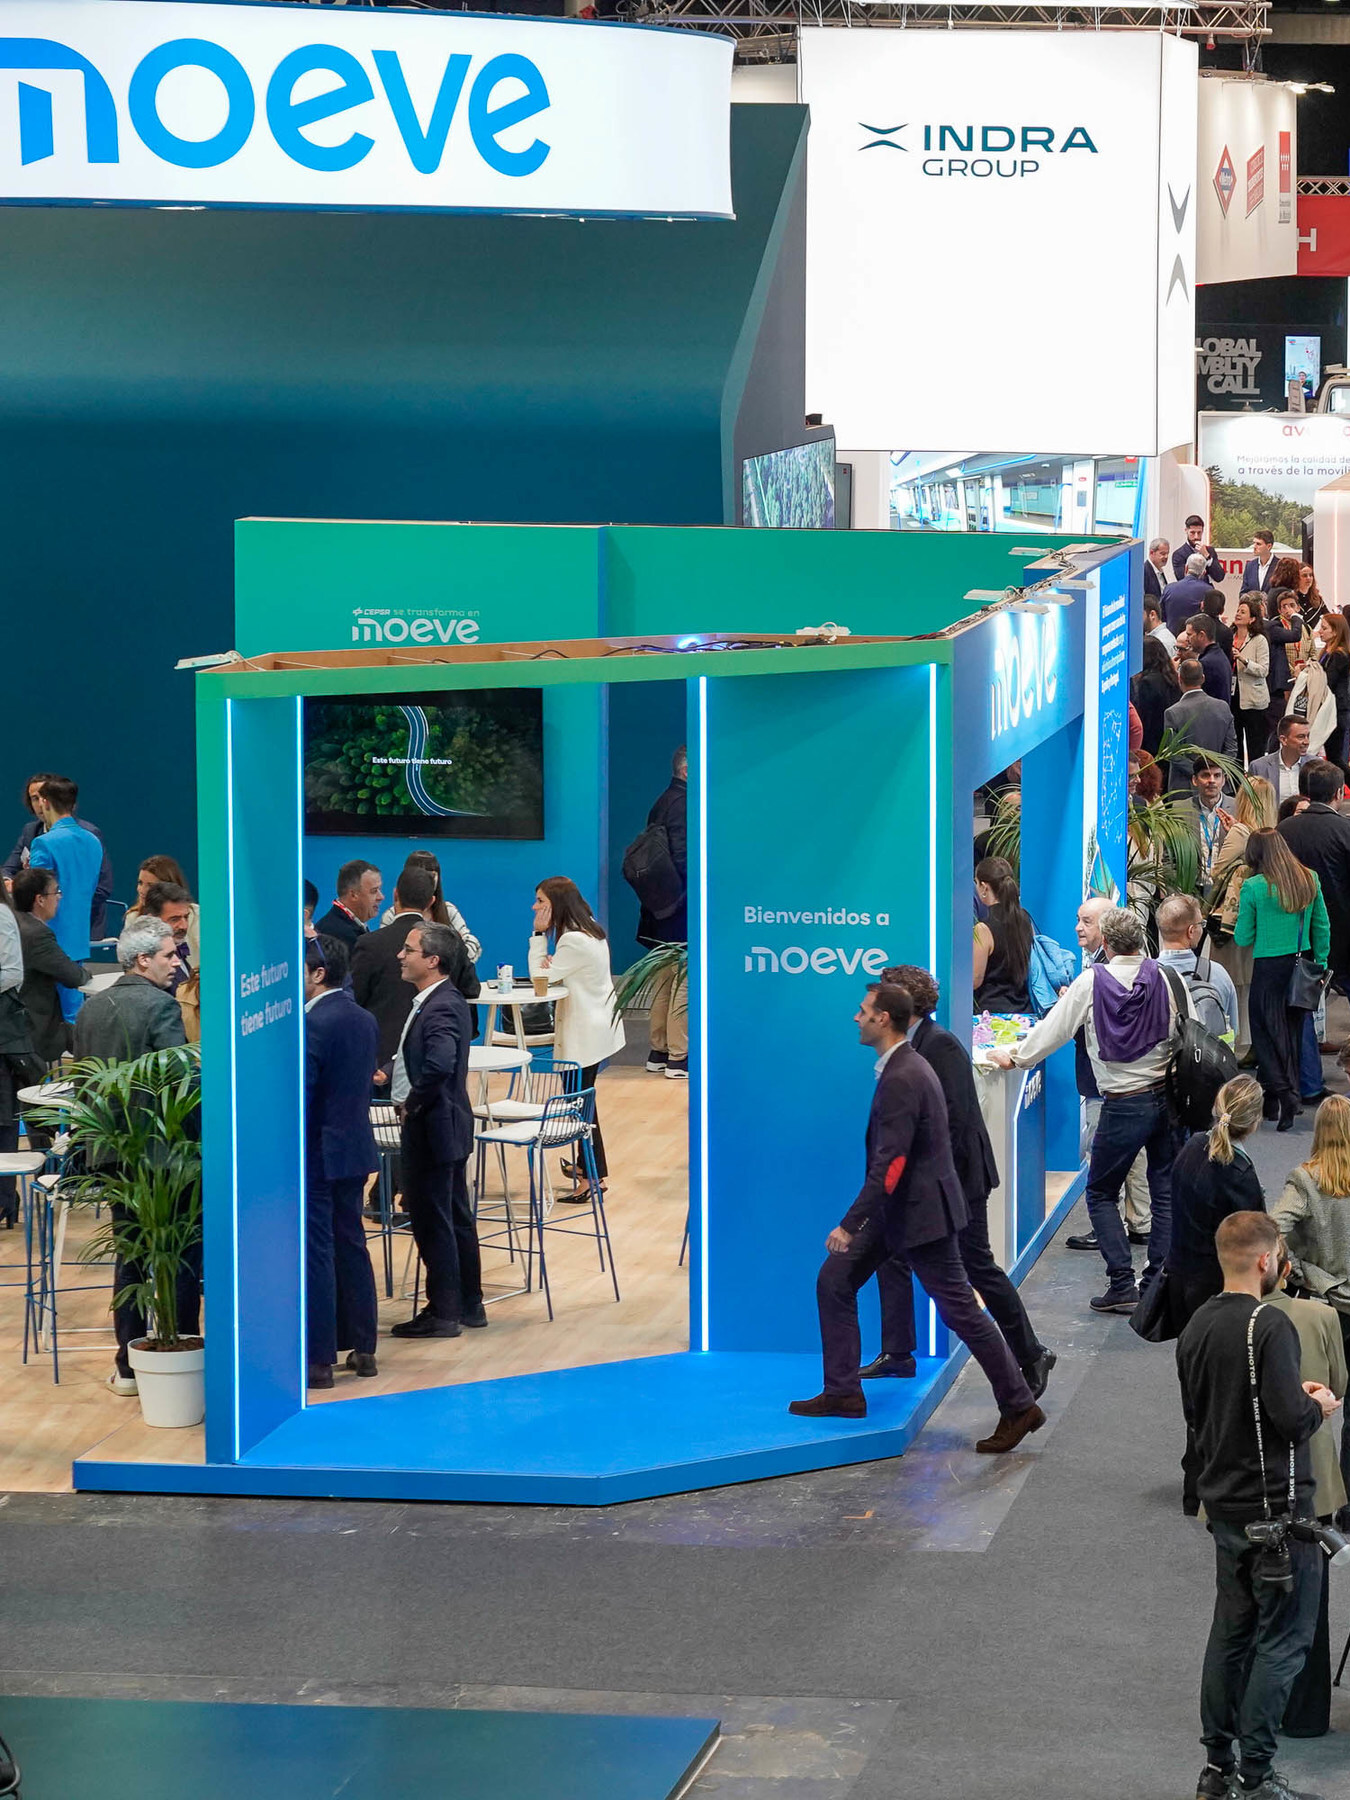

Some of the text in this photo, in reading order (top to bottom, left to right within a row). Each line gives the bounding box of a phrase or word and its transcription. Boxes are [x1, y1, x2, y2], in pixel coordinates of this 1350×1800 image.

[924, 125, 1099, 153] INDRA
[922, 158, 1039, 177] GROUP
[1207, 375, 1260, 394] CALL
[1290, 455, 1300, 464] la
[1302, 455, 1336, 464] calidad
[1340, 456, 1350, 464] de
[1248, 466, 1283, 475] través
[1286, 466, 1300, 475] de
[1303, 466, 1314, 475] la
[364, 608, 391, 616] CEPSA
[408, 608, 465, 617] transforma
[351, 617, 480, 643] moeve
[372, 756, 452, 765] Este futuro tiene futuro
[744, 906, 890, 926] Bienvenidos a
[744, 946, 889, 976] moeve
[240, 961, 289, 998] Este futuro
[241, 997, 292, 1037] tiene futuro
[1252, 1396, 1260, 1421] TAKE
[1288, 1478, 1296, 1500] TAKE
